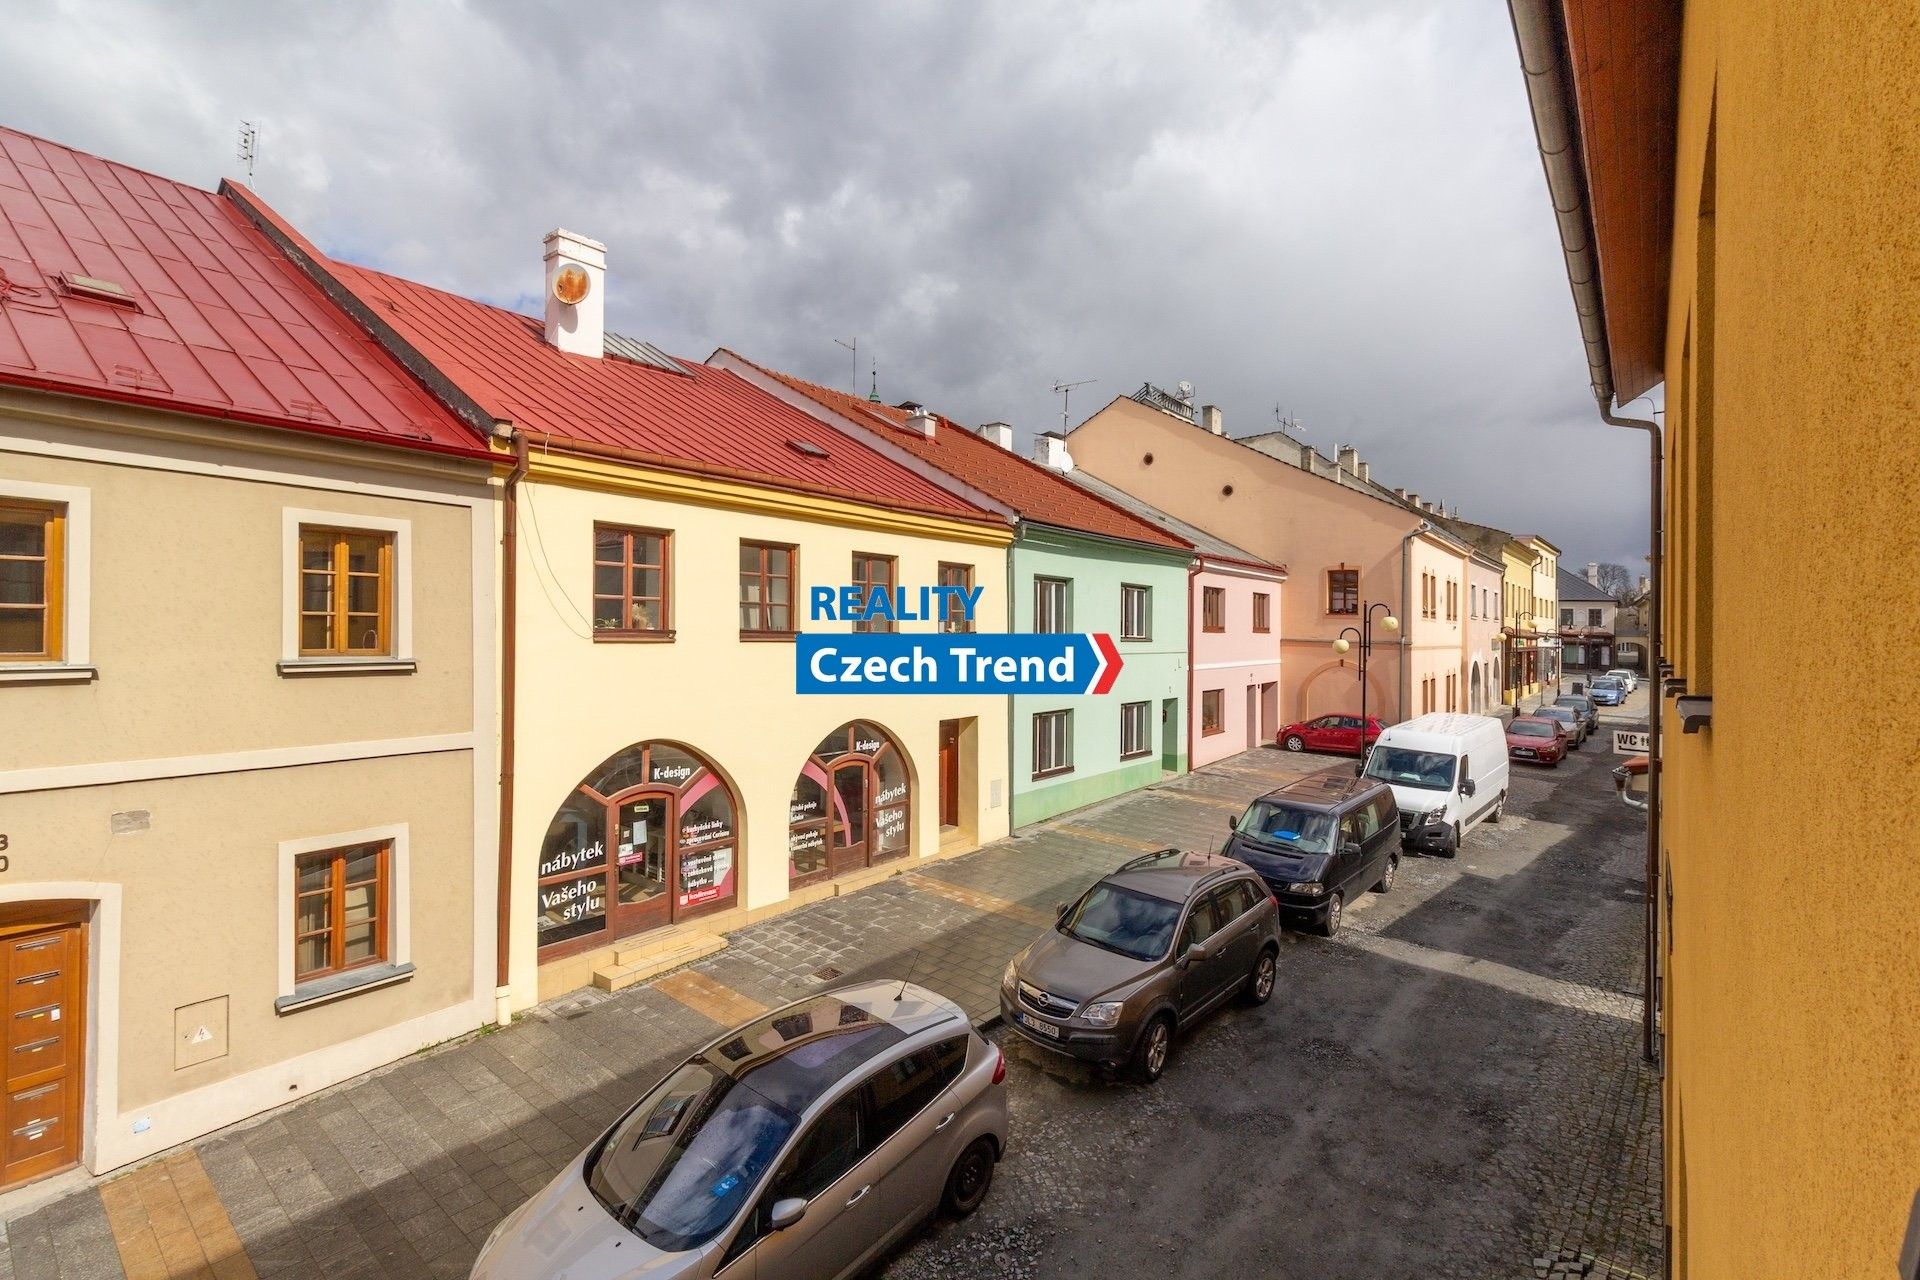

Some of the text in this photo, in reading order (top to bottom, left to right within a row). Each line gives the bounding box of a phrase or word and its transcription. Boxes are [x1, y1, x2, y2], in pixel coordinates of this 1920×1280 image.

[856, 740, 880, 751] K-design
[1617, 733, 1637, 746] WC
[654, 766, 691, 780] K-design
[875, 783, 907, 805] nábytek
[875, 809, 903, 828] Vašeho
[886, 821, 905, 837] stylu
[541, 841, 604, 875] nábytek
[541, 880, 598, 909] Vašeho
[563, 896, 600, 920] stylu
